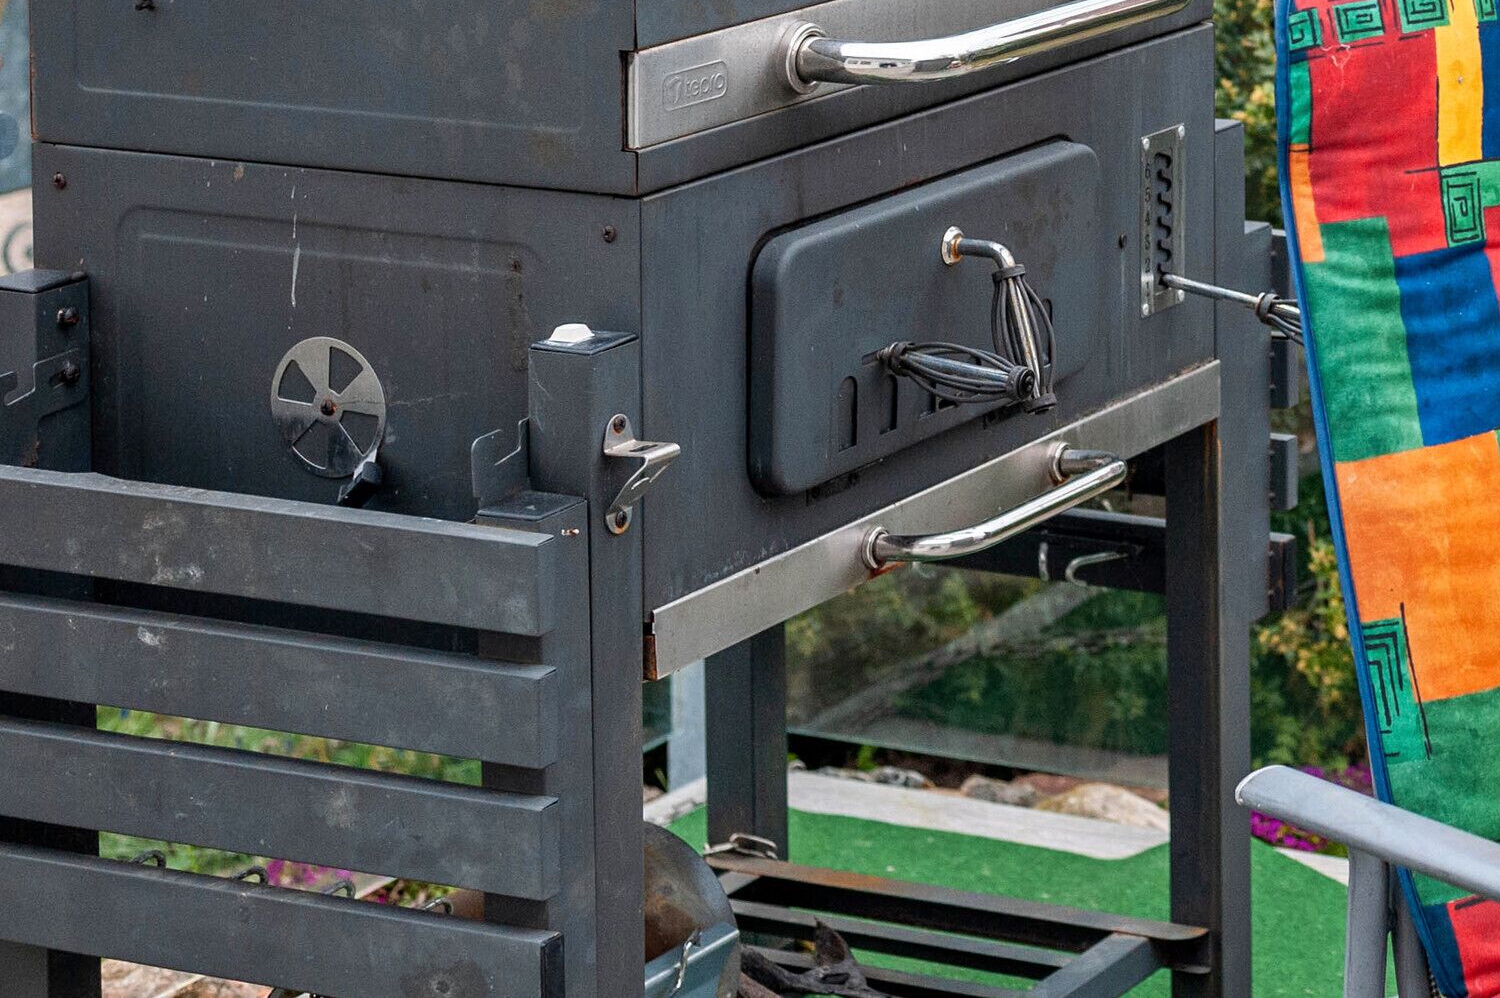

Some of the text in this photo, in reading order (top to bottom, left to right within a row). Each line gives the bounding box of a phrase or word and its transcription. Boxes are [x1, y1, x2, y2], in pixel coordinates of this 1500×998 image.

[684, 72, 726, 99] tepro
[1144, 162, 1151, 179] 6
[1144, 186, 1151, 203] 5
[1144, 257, 1151, 274] 2
